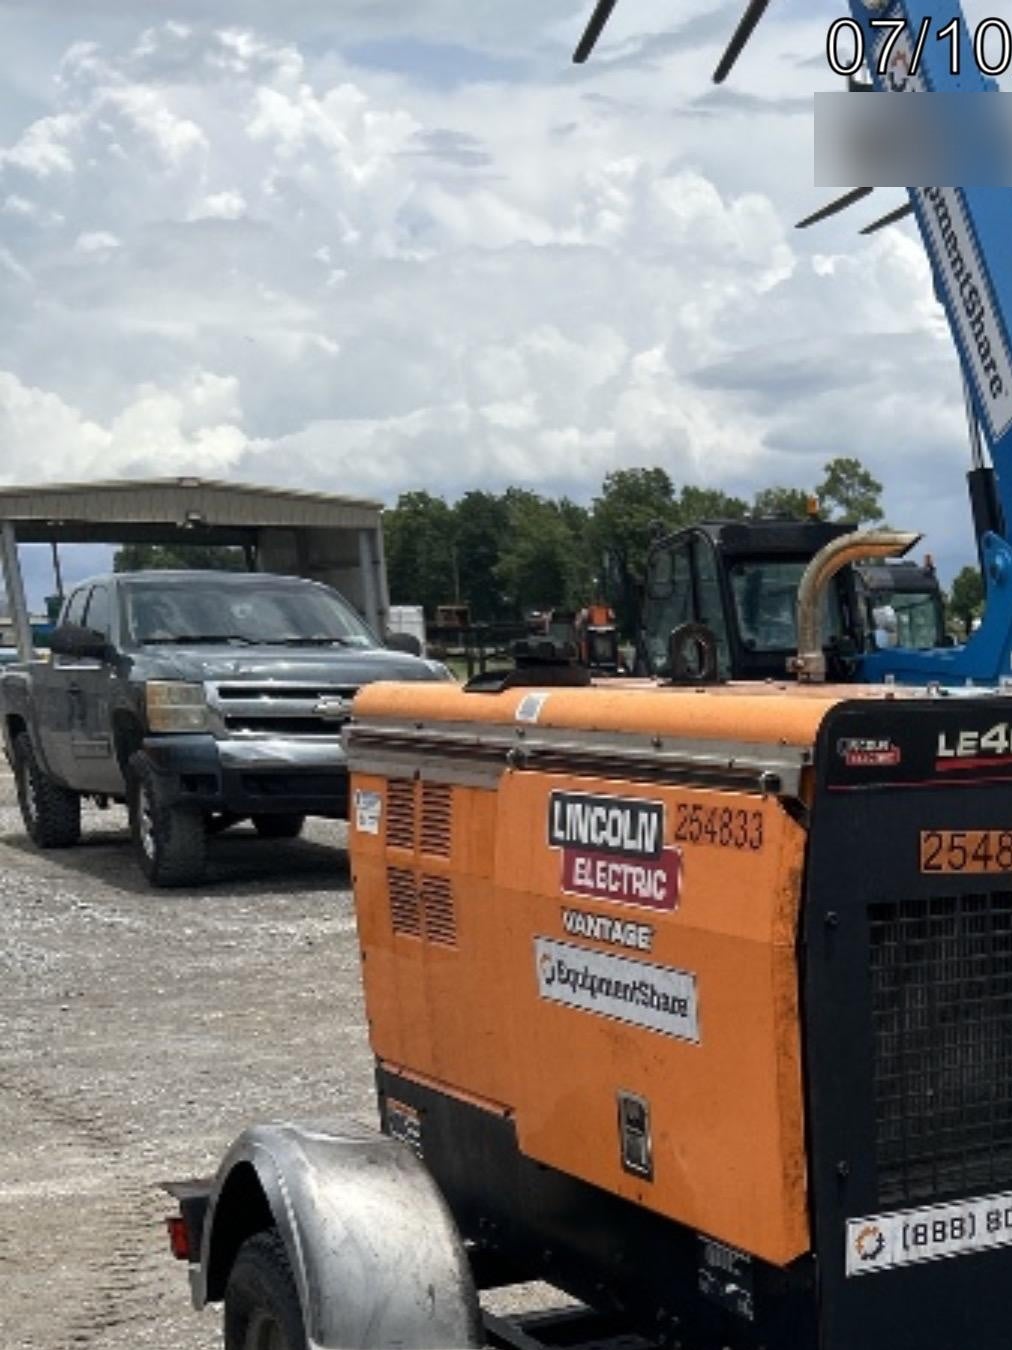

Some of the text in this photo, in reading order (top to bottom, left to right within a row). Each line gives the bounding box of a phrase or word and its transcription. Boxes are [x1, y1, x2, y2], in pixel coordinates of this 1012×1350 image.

[923, 187, 1005, 400] pmentShare
[552, 800, 661, 853] LINCOLN
[674, 804, 764, 850] 254833
[572, 857, 668, 901] ELECTRIC
[562, 909, 654, 951] VANTAGE
[556, 961, 689, 1017] EquipmentShare
[902, 1211, 976, 1250] (888)
